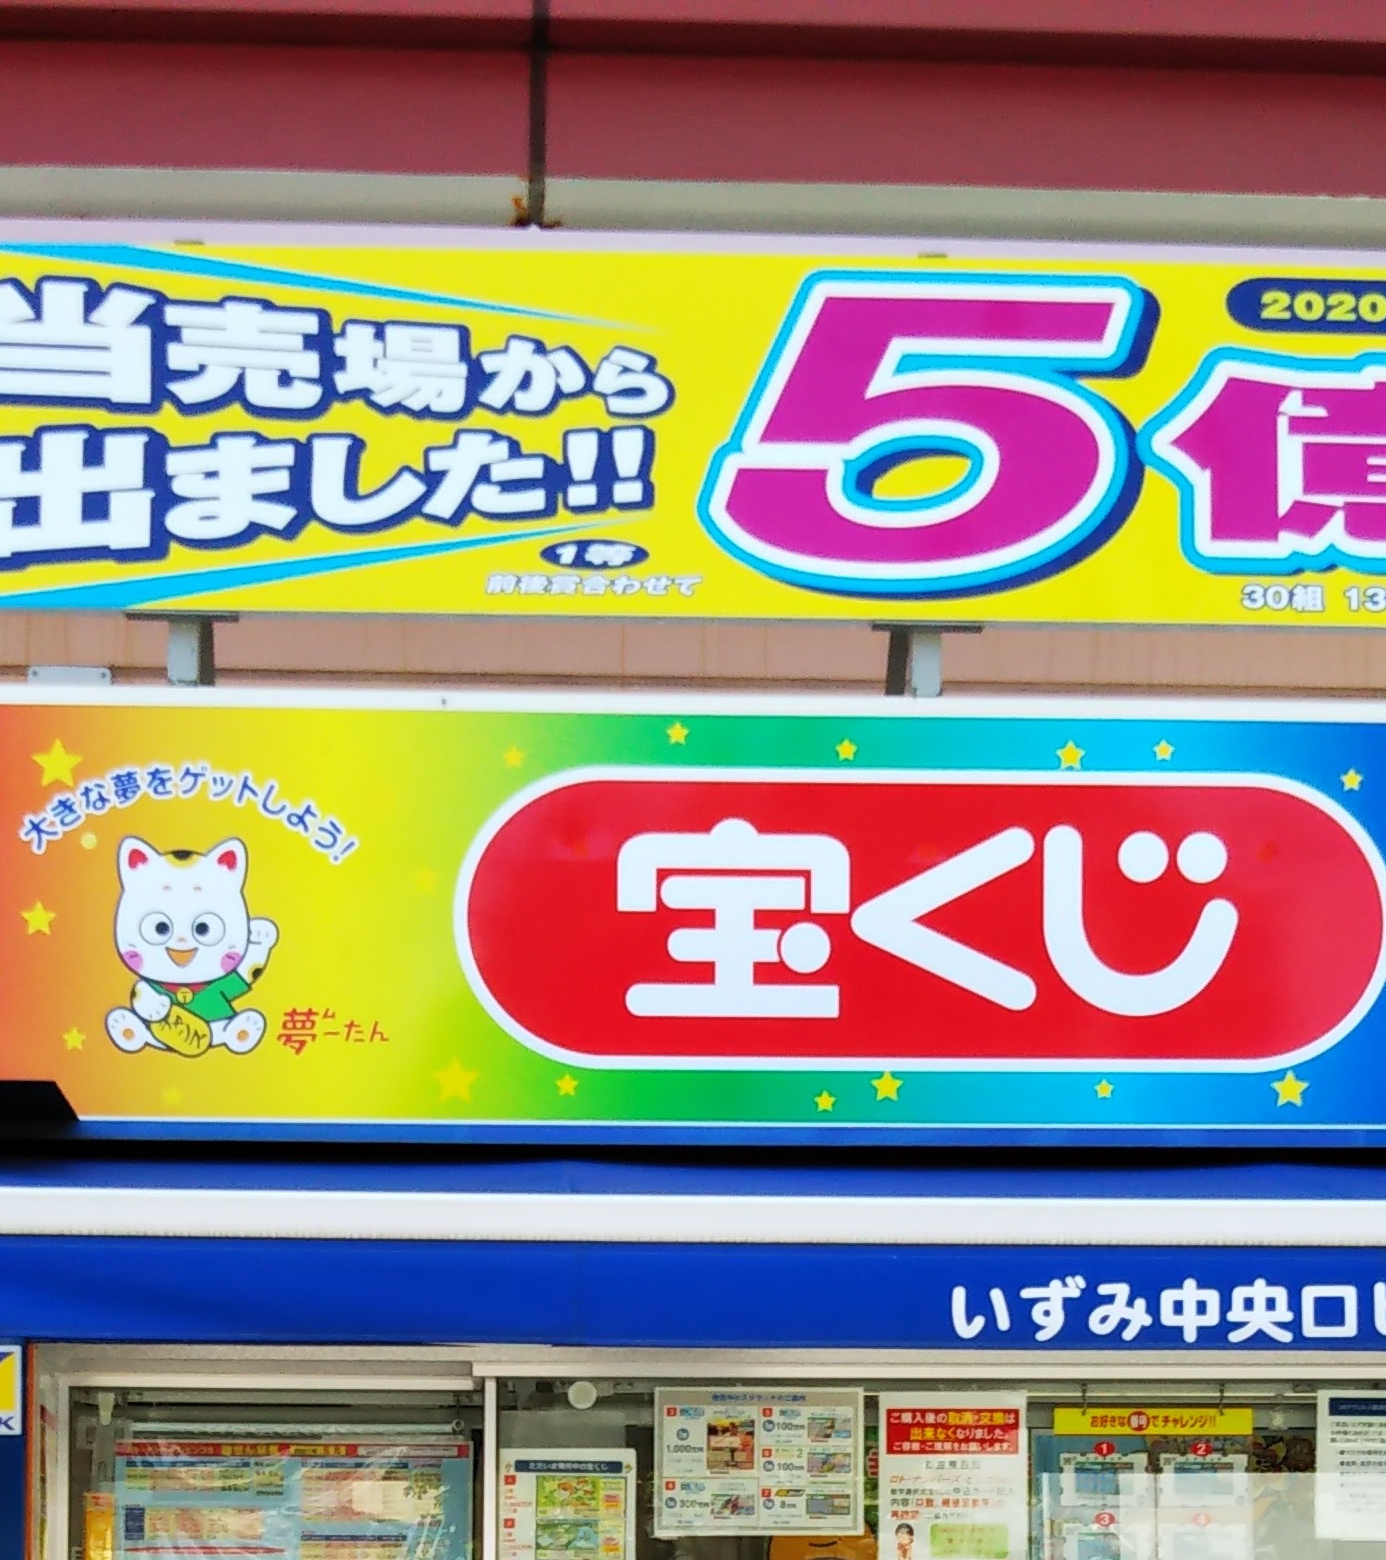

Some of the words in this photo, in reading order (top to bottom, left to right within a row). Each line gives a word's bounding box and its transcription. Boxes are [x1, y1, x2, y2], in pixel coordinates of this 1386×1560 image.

[1240, 583, 1326, 613] 30組
[20, 764, 358, 865] 大きな夢をゲットしよう!
[616, 817, 1239, 1018] 宝くじ
